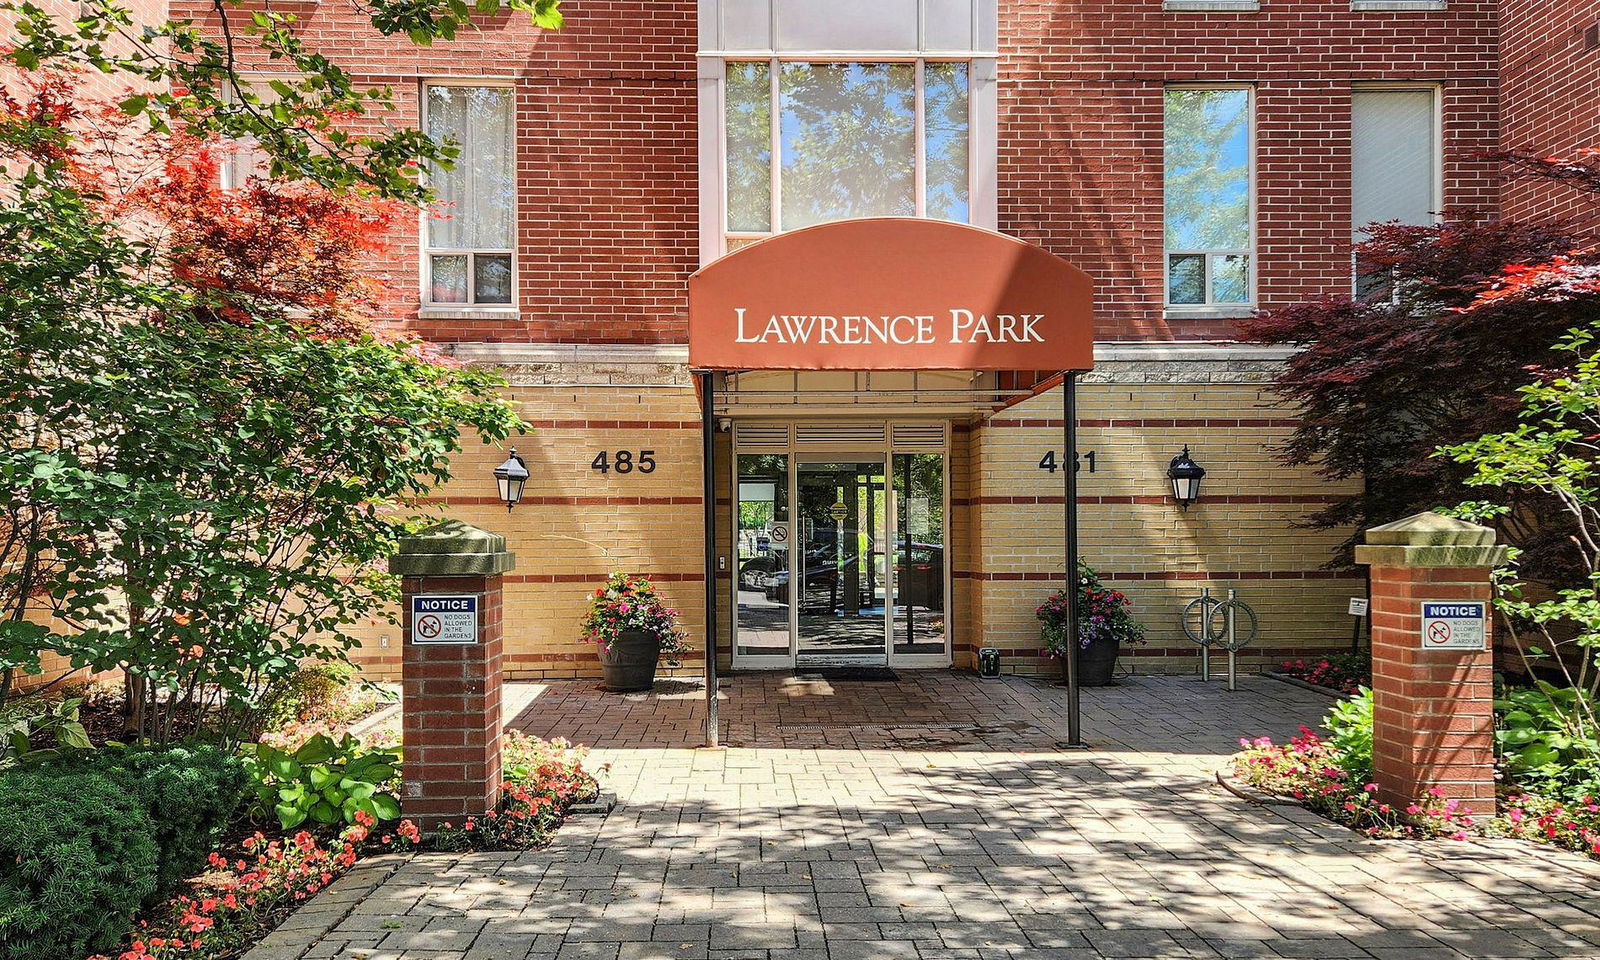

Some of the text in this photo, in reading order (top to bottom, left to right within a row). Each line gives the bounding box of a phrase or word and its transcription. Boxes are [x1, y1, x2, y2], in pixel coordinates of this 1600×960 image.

[734, 308, 1045, 344] LAWRENCE PARK
[591, 450, 656, 474] 485
[421, 600, 468, 610] NOTICE
[1430, 606, 1477, 616] NOTICE
